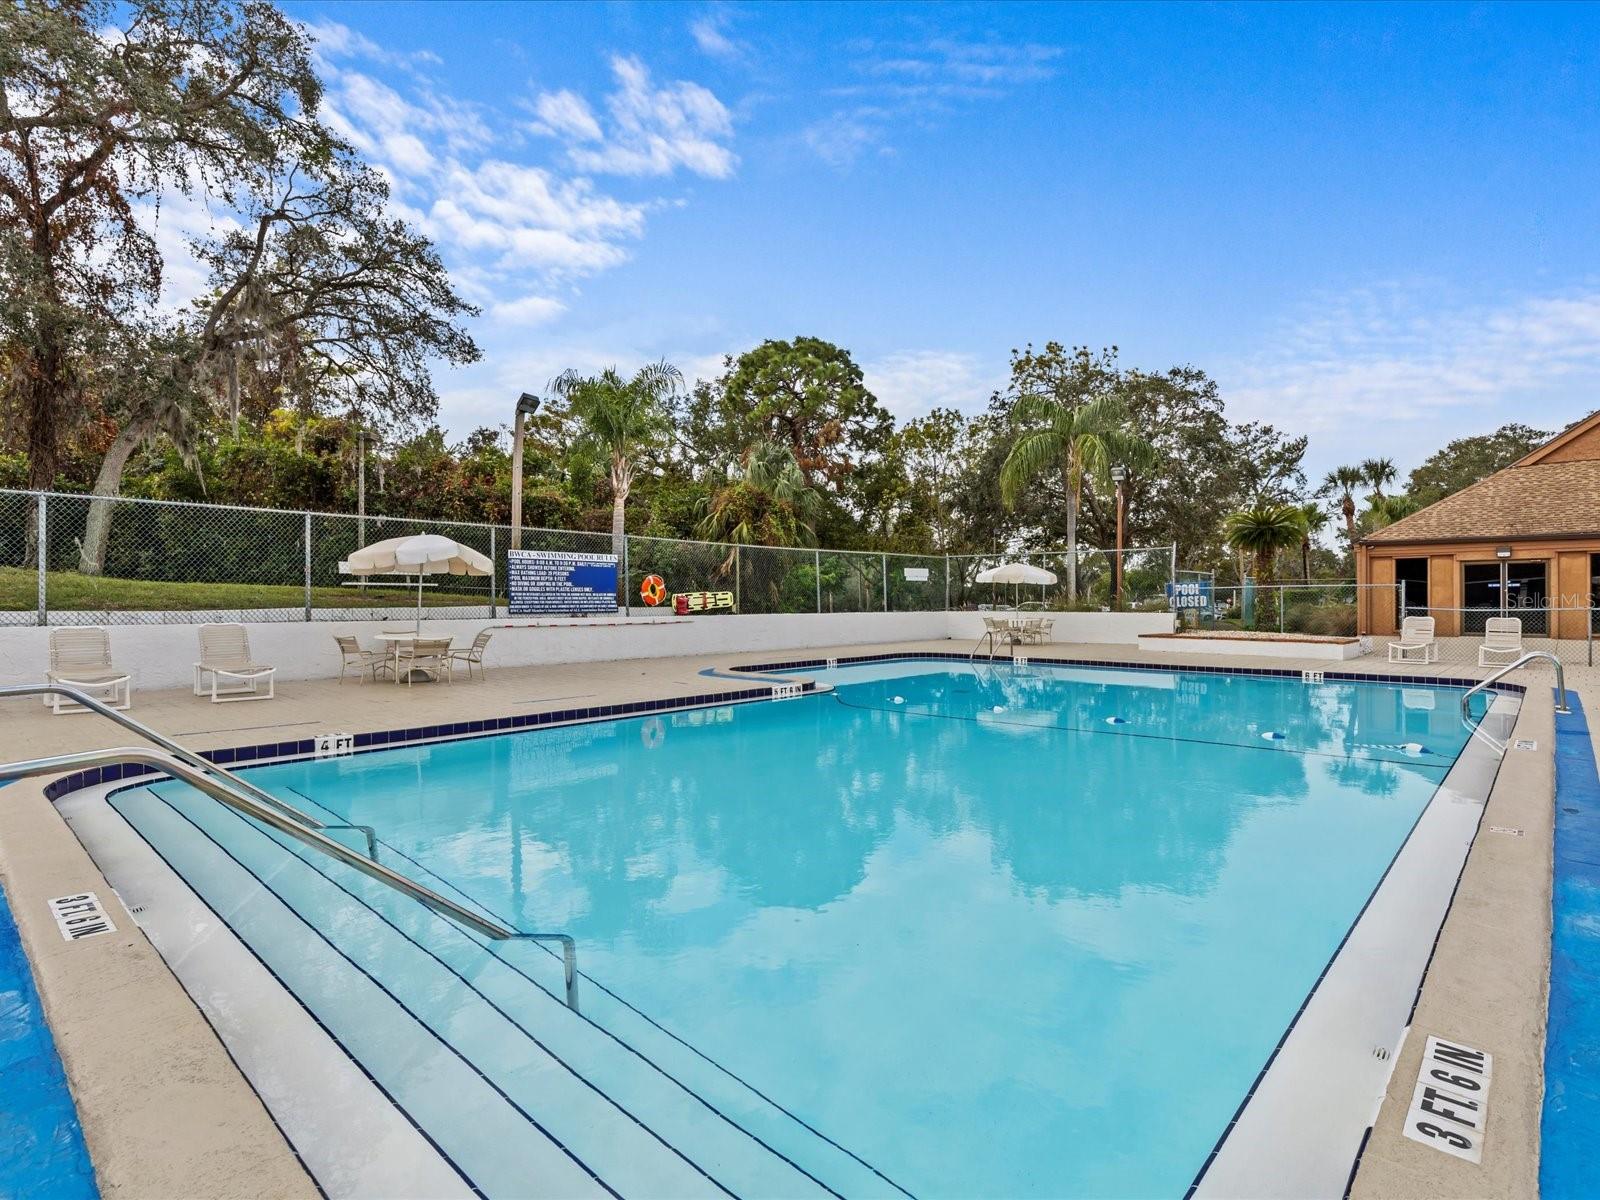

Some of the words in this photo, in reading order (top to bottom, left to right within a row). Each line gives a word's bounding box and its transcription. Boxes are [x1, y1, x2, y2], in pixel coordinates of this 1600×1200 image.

[536, 552, 576, 560] SWIMMING
[1175, 584, 1200, 595] POOL
[1170, 596, 1207, 608] CLOSED
[320, 740, 329, 750] 4
[336, 738, 352, 749] FT
[56, 896, 89, 904] 3
[66, 916, 101, 925] 6
[68, 922, 109, 940] IN.
[1433, 1042, 1484, 1074] IN.
[1430, 1069, 1481, 1091] 6
[1420, 1086, 1478, 1128] FT.
[1416, 1122, 1472, 1150] 3
